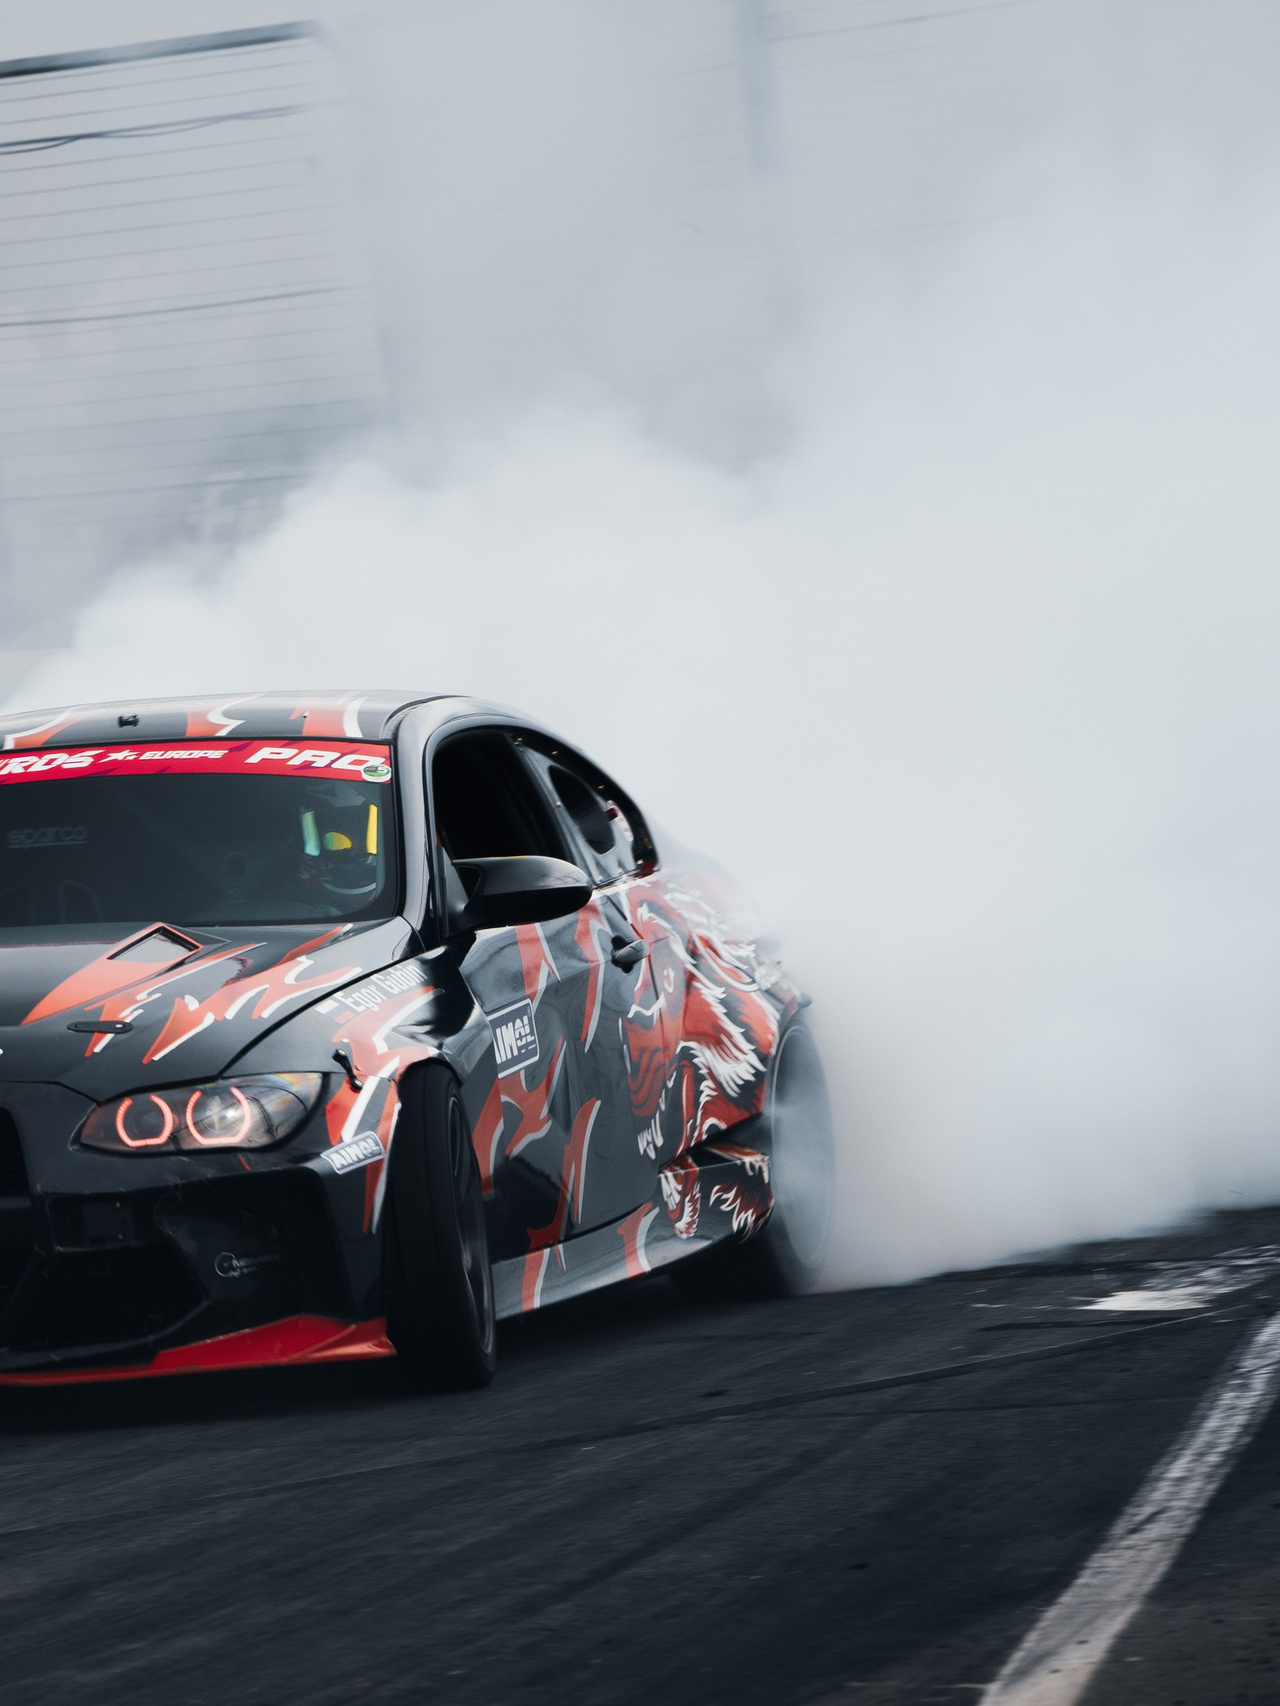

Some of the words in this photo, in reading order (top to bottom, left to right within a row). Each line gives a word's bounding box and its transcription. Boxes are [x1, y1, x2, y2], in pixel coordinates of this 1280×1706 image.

[139, 749, 230, 760] EUROPE
[244, 746, 388, 771] PRO
[332, 983, 388, 1013] Egor
[370, 964, 429, 995] Gubin
[329, 1137, 381, 1169] AIMOL
